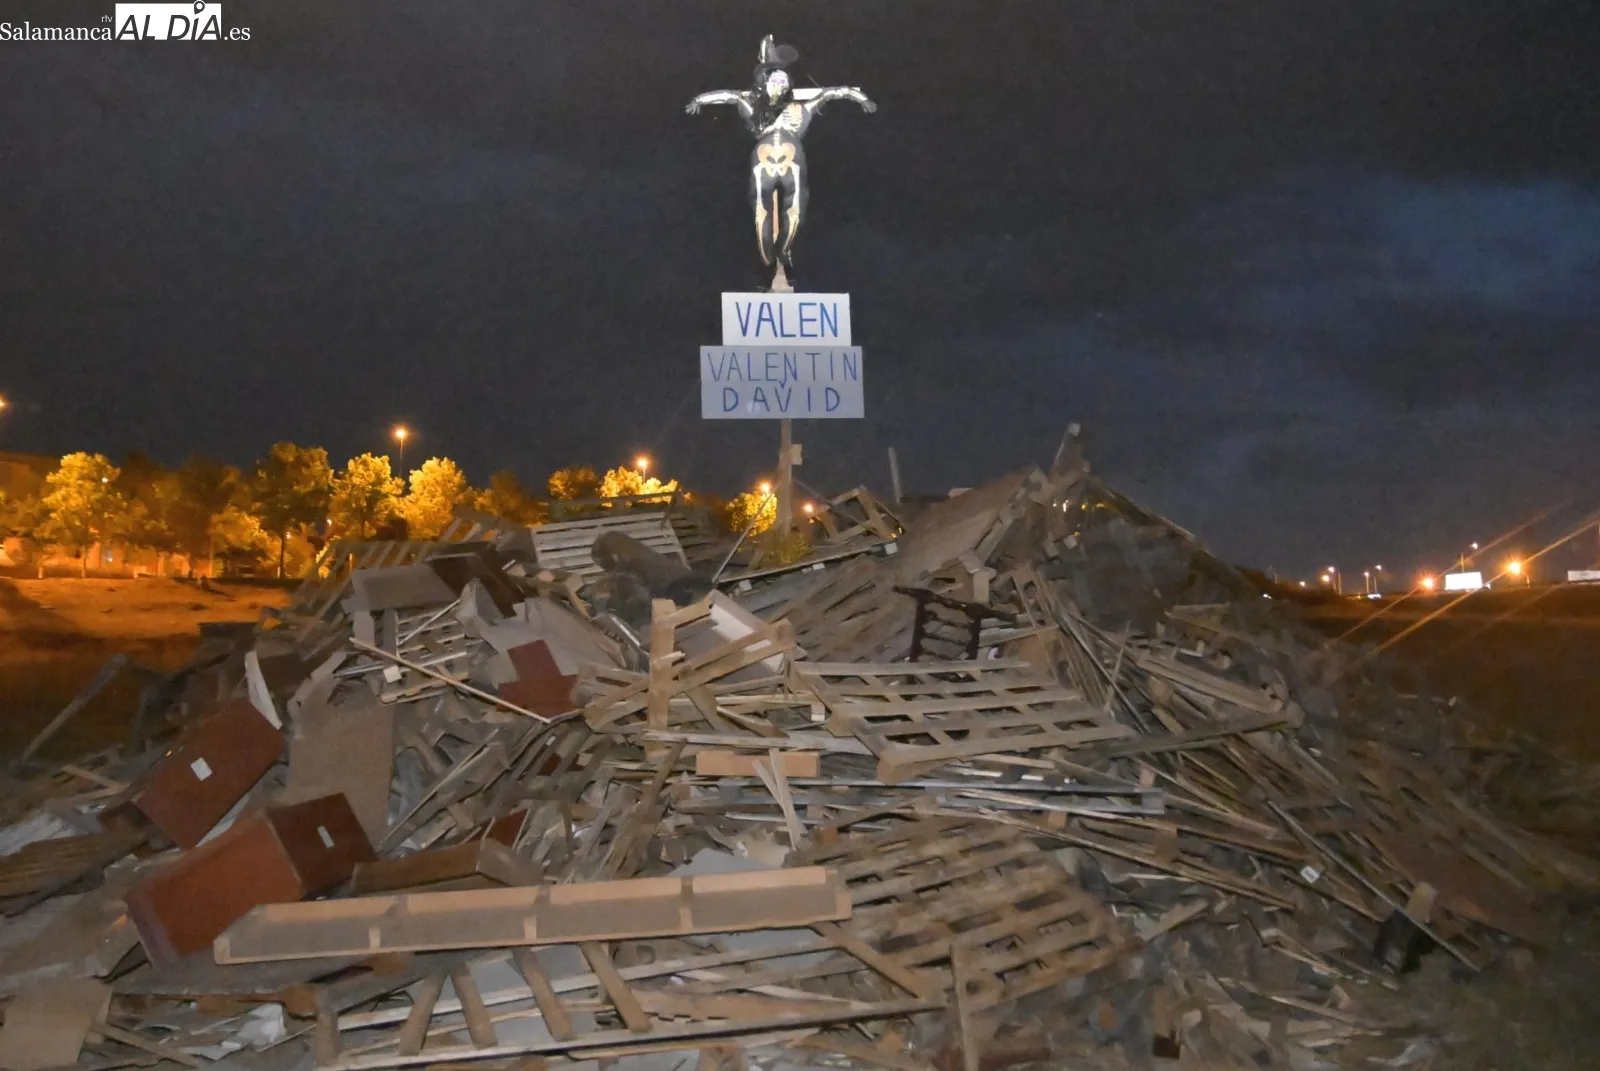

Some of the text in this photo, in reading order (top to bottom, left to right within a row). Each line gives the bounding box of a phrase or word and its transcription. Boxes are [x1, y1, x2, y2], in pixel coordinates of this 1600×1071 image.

[735, 301, 839, 338] VALEN
[707, 351, 858, 382] VALENTIN
[722, 386, 841, 413] DAVID
